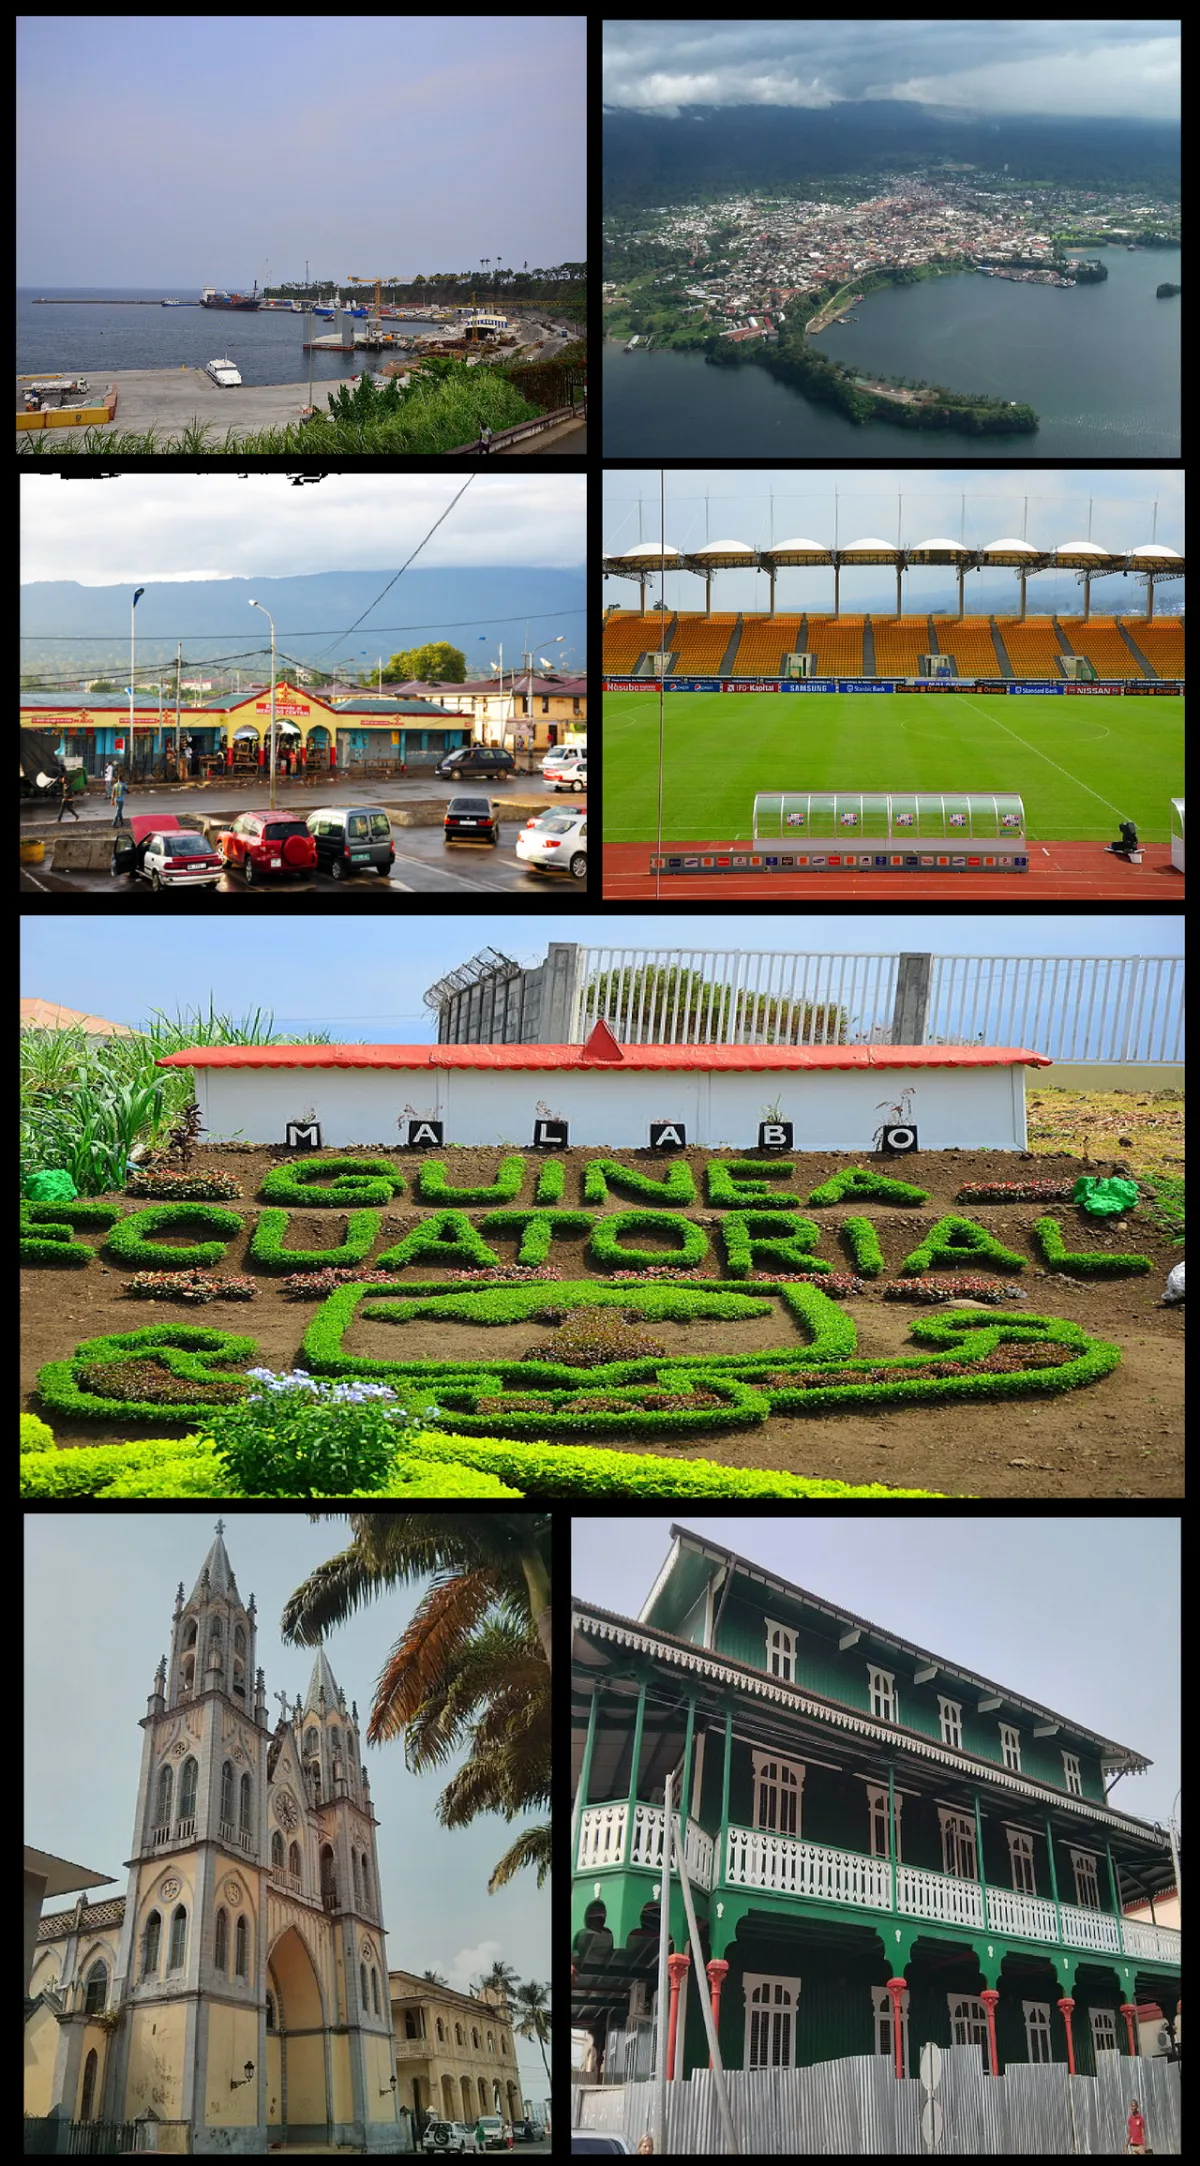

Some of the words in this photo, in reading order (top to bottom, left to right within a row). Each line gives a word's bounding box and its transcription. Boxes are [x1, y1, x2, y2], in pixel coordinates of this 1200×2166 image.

[790, 684, 827, 692] SAMSUNG
[854, 684, 872, 692] Stanbic
[897, 685, 919, 693] Orange
[927, 685, 949, 693] Orange
[954, 685, 976, 693] Orange
[983, 686, 1005, 694] Orange
[1076, 687, 1111, 695] NISSAN
[259, 1155, 933, 1209] GUINEA
[20, 1198, 1155, 1279] ECUATORIAL
